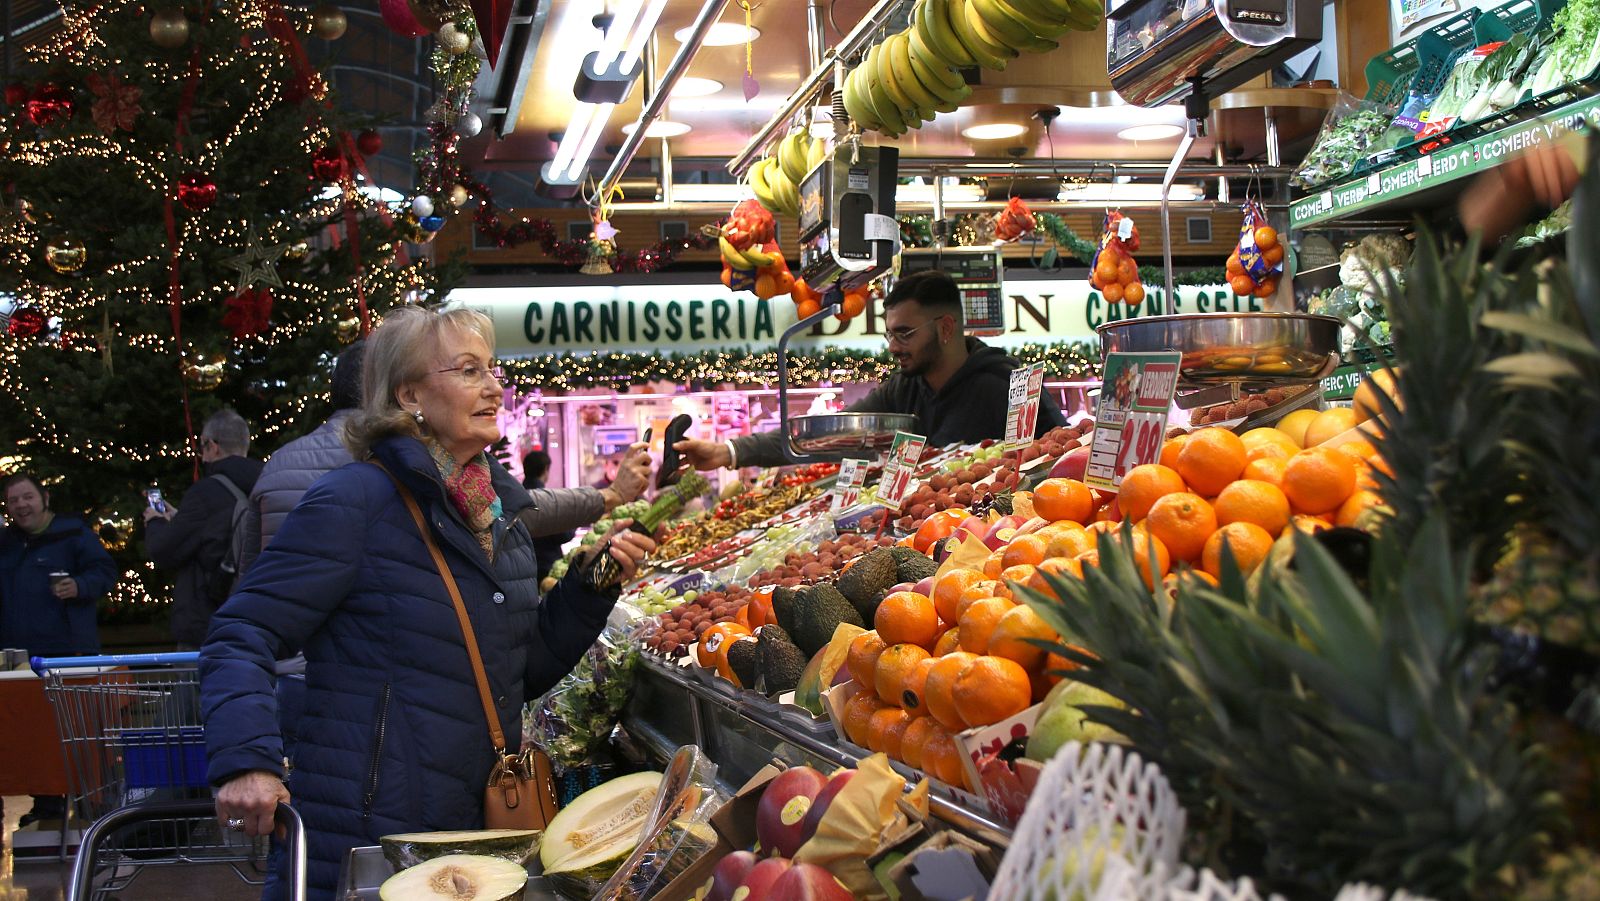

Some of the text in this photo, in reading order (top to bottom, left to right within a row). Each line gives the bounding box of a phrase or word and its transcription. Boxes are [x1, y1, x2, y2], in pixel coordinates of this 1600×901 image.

[1295, 197, 1334, 221] COME
[1426, 153, 1458, 178] ERD
[524, 299, 774, 345] CARNISSERIA
